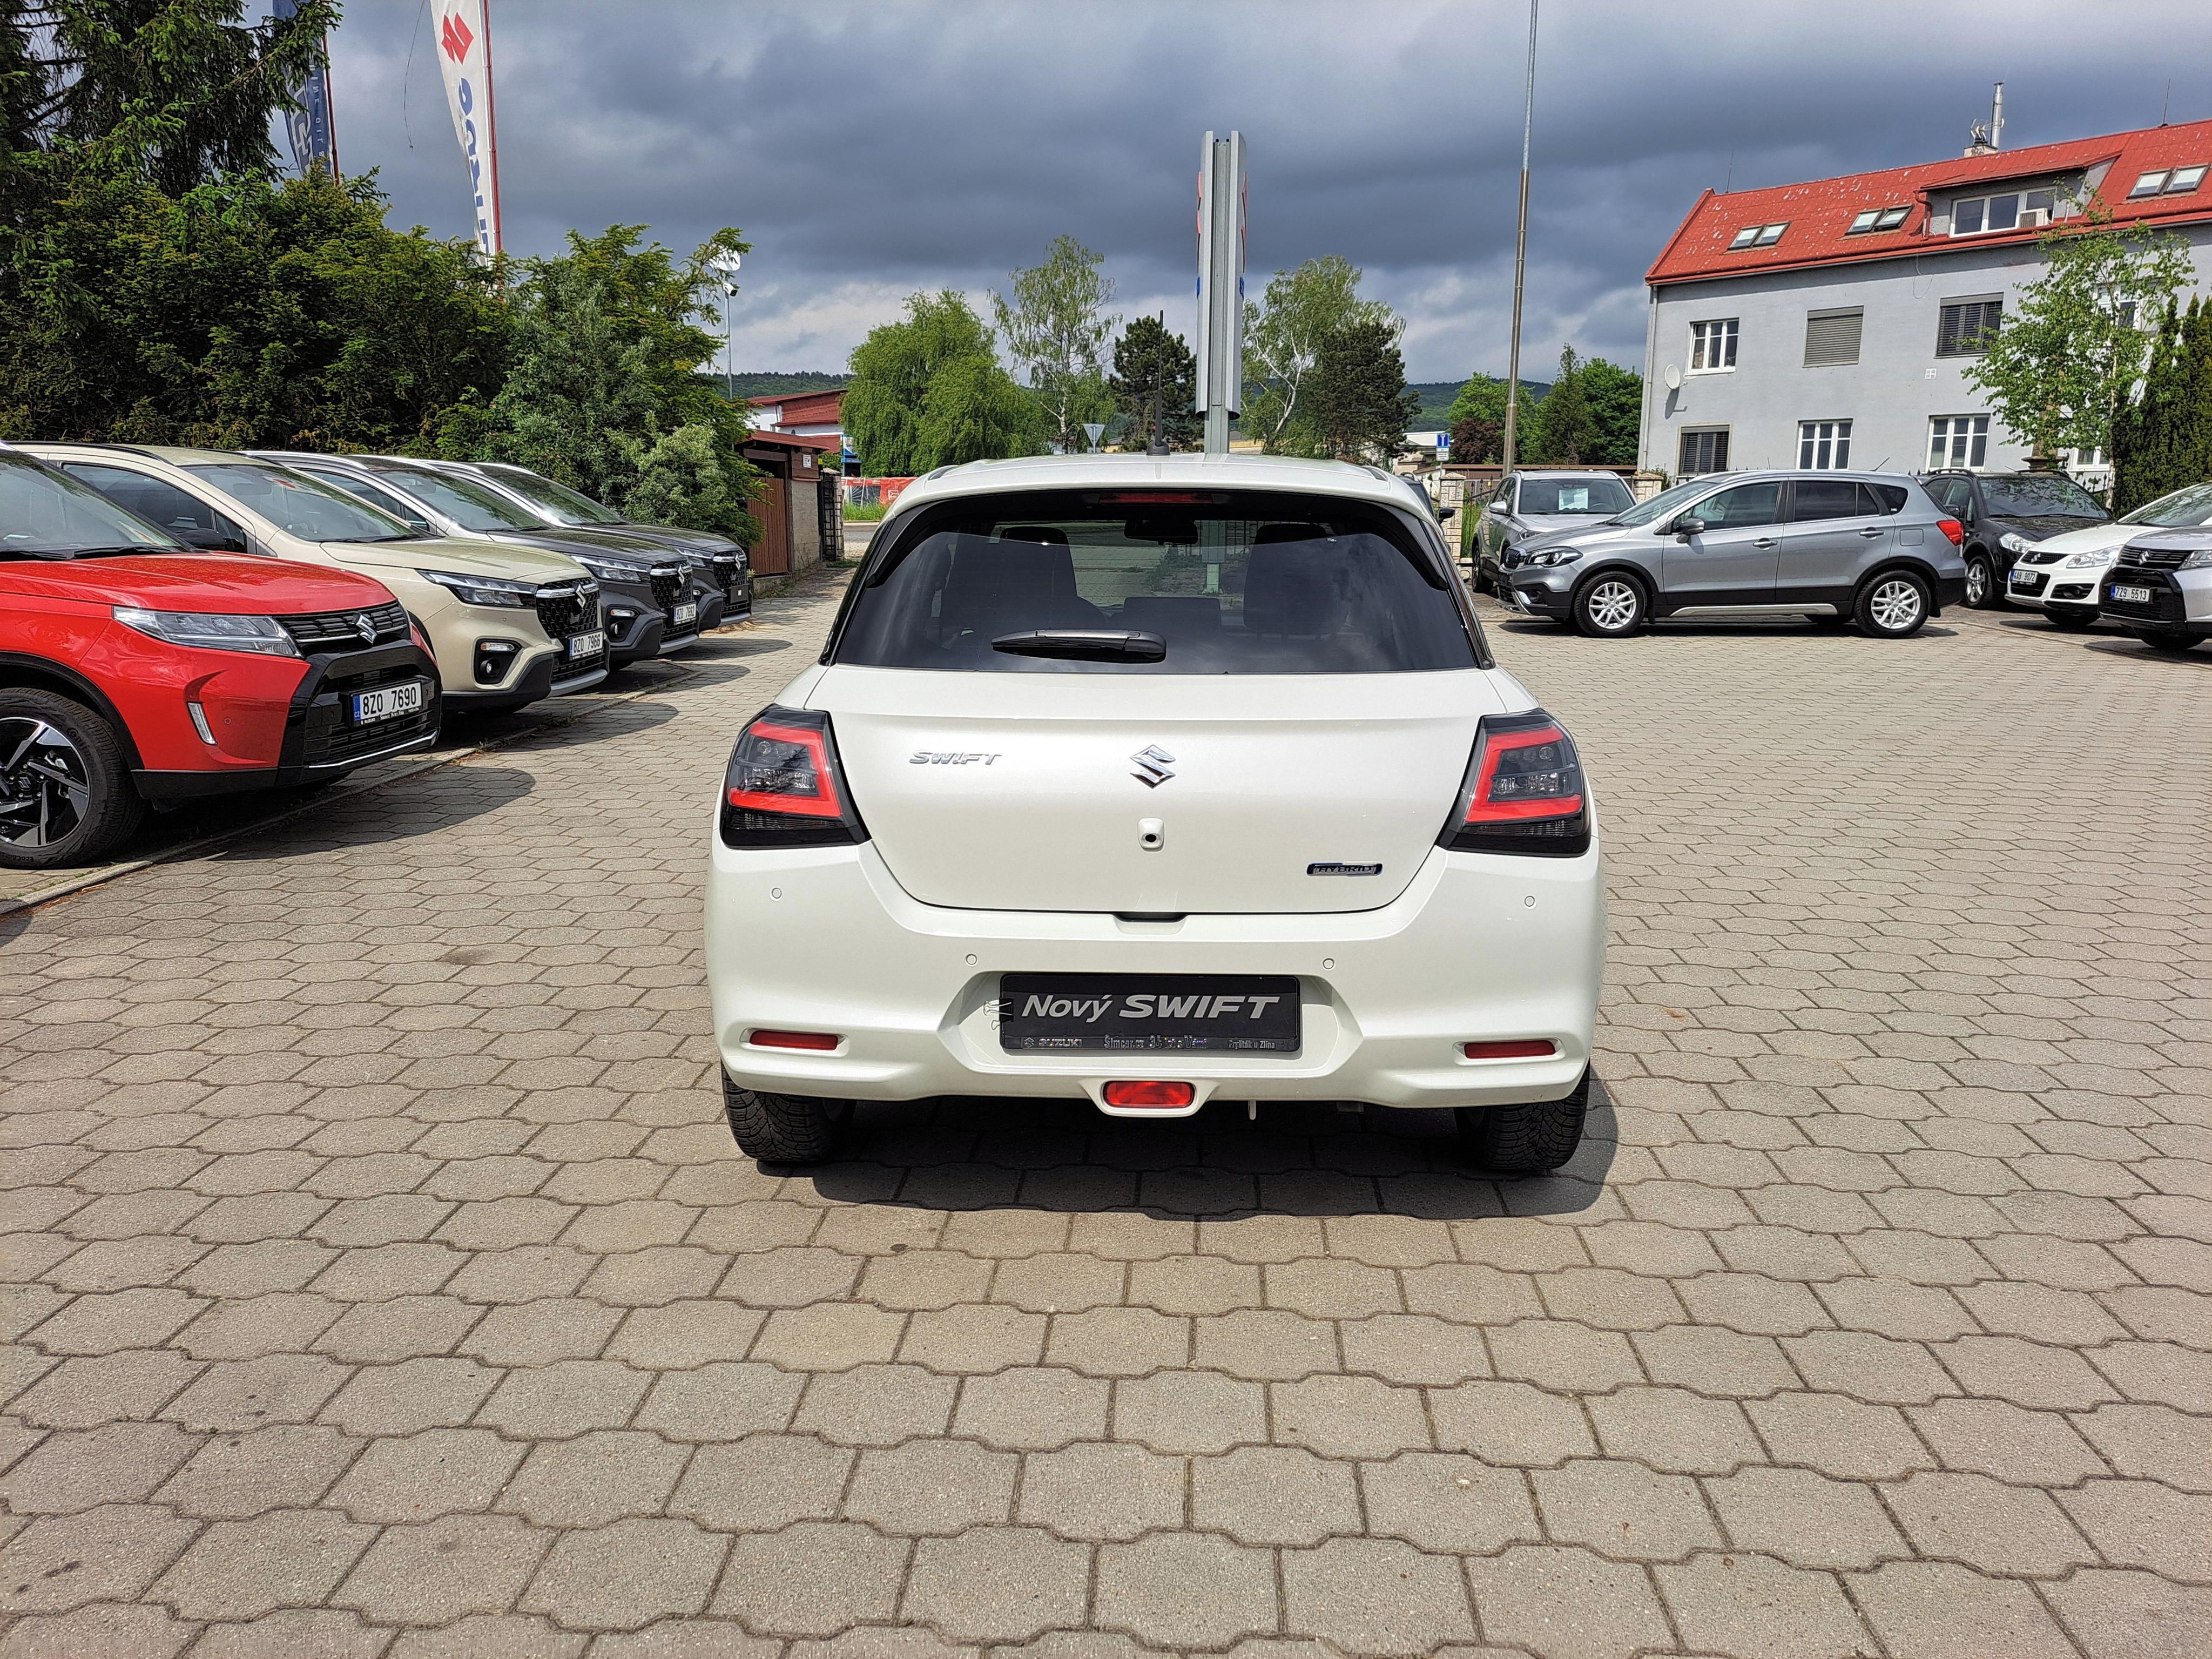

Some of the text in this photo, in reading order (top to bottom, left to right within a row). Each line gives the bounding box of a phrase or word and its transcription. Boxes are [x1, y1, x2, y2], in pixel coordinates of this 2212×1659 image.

[2115, 587, 2147, 600] 7Z9 5513
[574, 633, 601, 653] 8Z0 7966
[363, 686, 416, 715] 8Z0 7690
[909, 750, 1003, 765] SWIFT
[1021, 994, 1280, 1023] Nový SWIFT
[1038, 1038, 1082, 1047] SUZUKI
